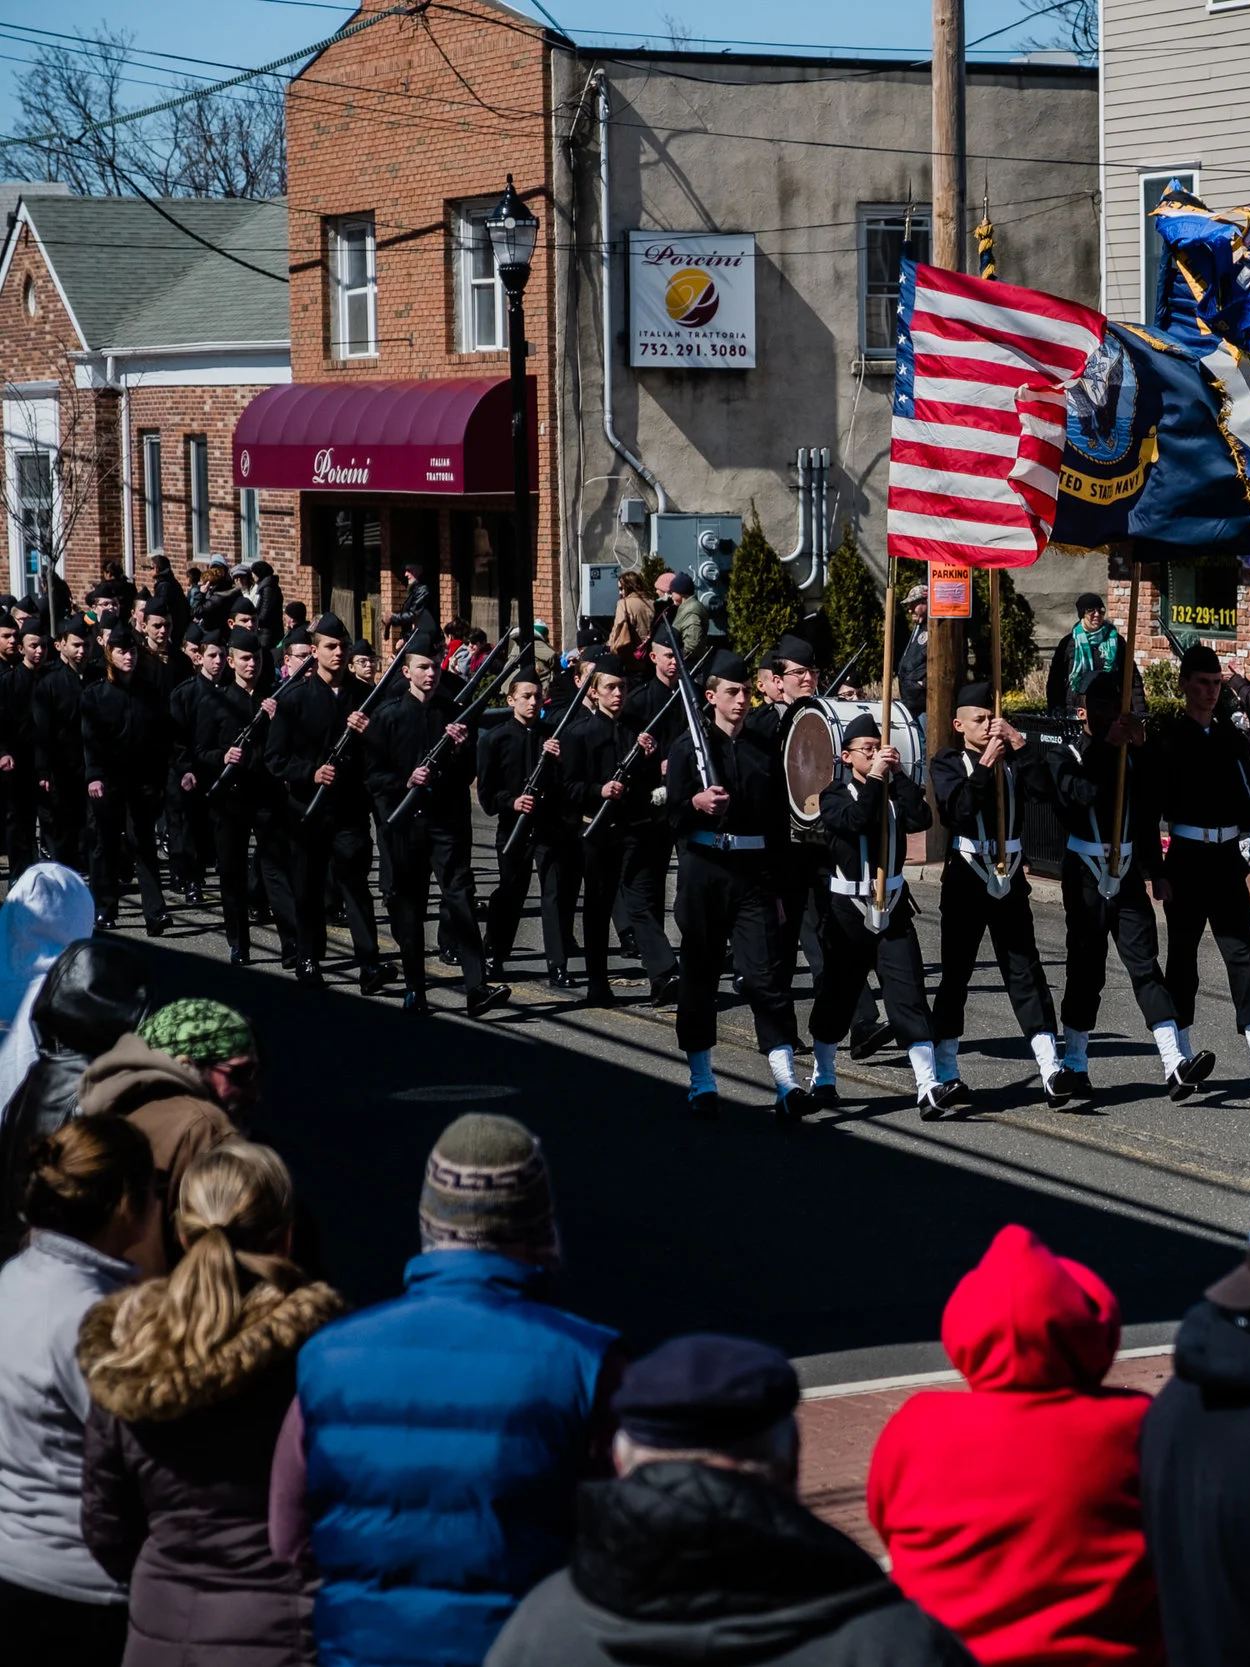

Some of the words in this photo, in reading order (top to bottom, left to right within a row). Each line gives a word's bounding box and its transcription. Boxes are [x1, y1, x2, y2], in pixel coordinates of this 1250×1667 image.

[641, 243, 746, 267] Porcini
[639, 330, 681, 338] ITALIAN
[688, 331, 746, 339] TRATTORIA
[640, 343, 747, 357] 732.291.3080
[312, 447, 372, 485] Porcini
[430, 458, 451, 467] ITALIAN
[426, 472, 454, 481] TRATTORIA
[1060, 471, 1082, 491] TED
[1115, 471, 1140, 495] NAVY
[932, 569, 968, 579] PARKING
